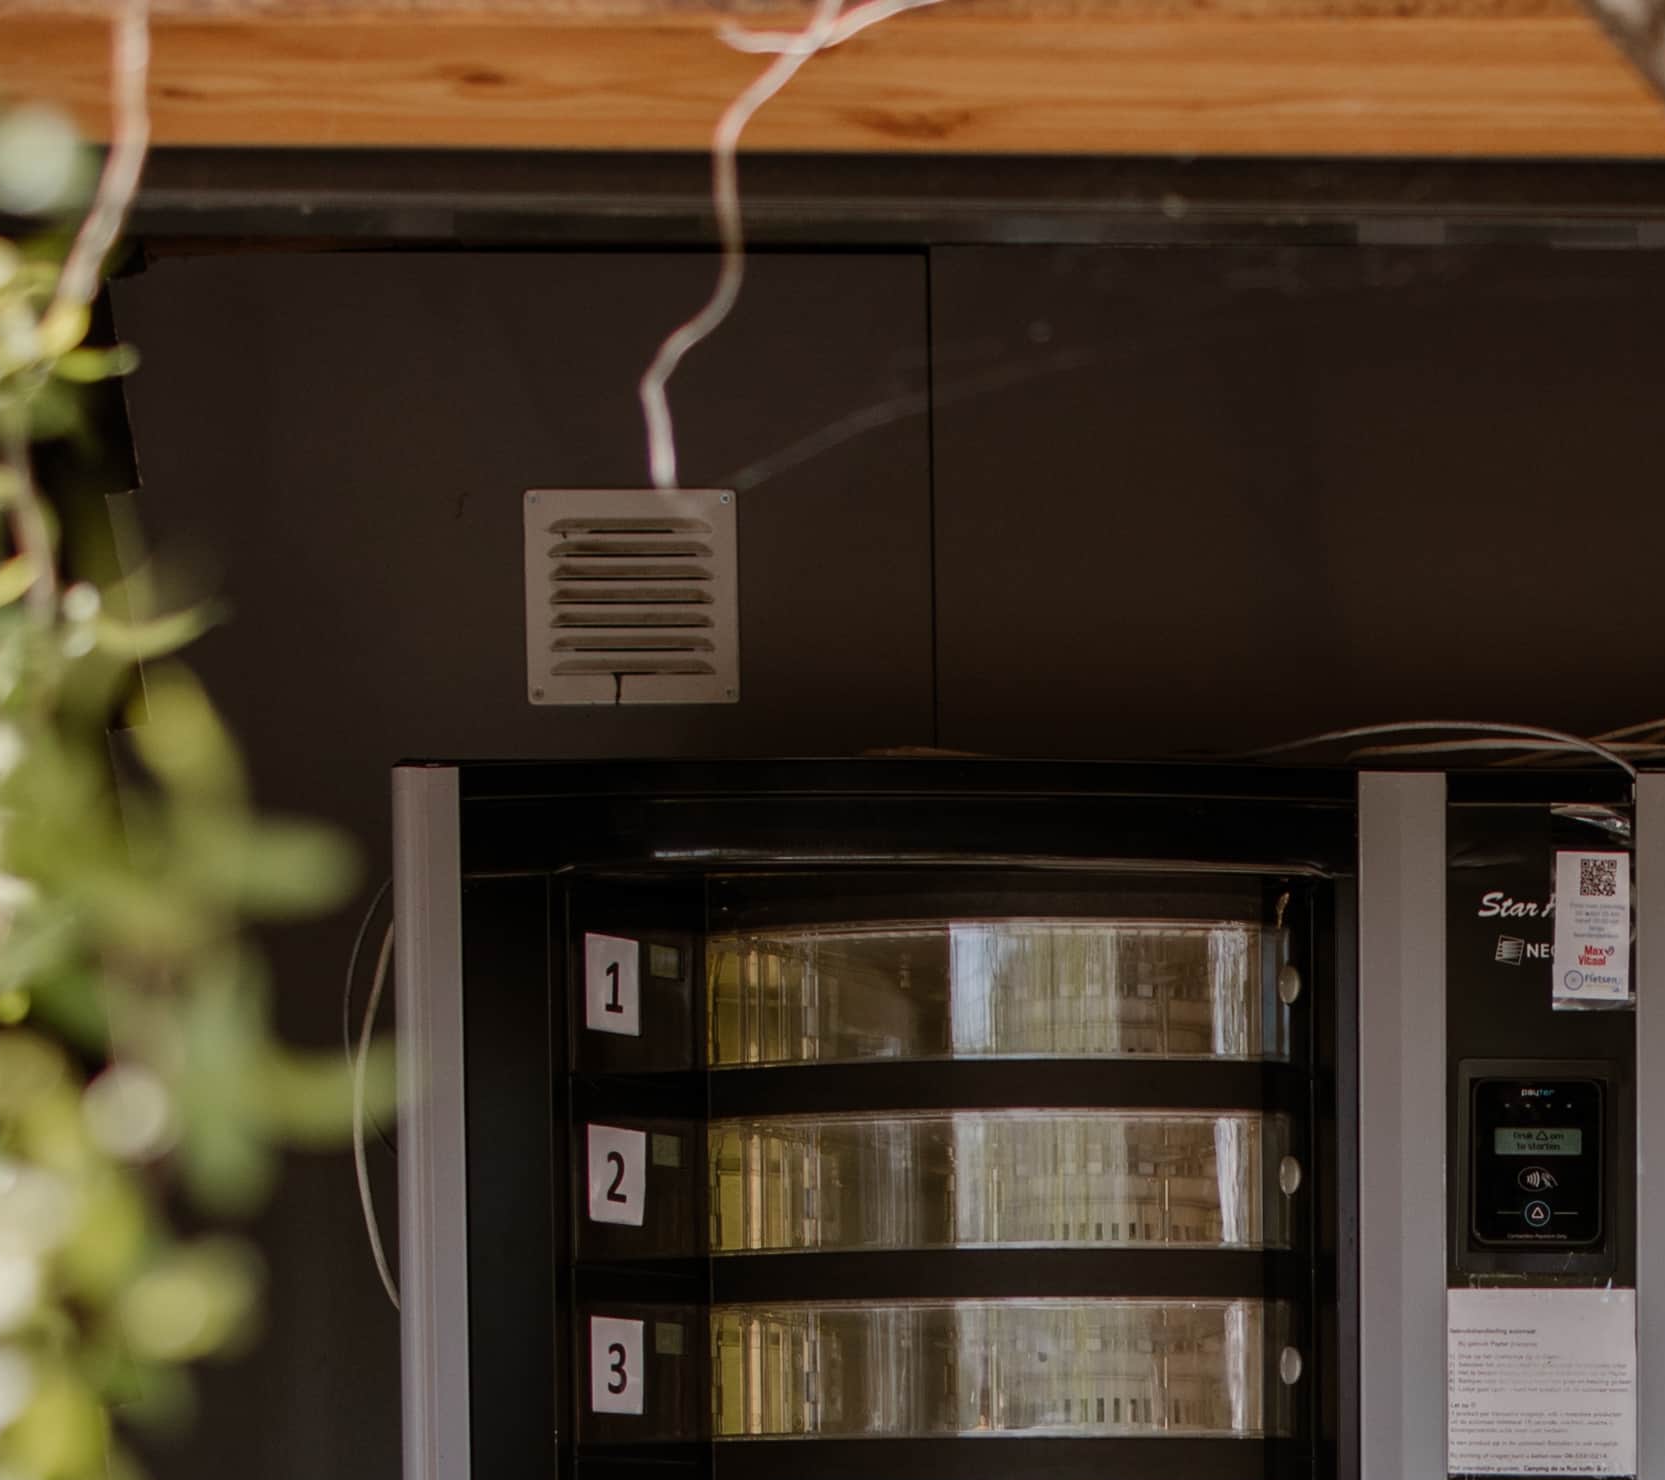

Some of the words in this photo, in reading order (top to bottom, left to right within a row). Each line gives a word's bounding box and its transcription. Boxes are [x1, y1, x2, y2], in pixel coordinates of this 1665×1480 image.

[1478, 891, 1538, 918] Star
[1526, 943, 1555, 958] NE
[605, 961, 624, 1014] 1
[606, 1151, 627, 1204] 2
[607, 1342, 627, 1395] 3
